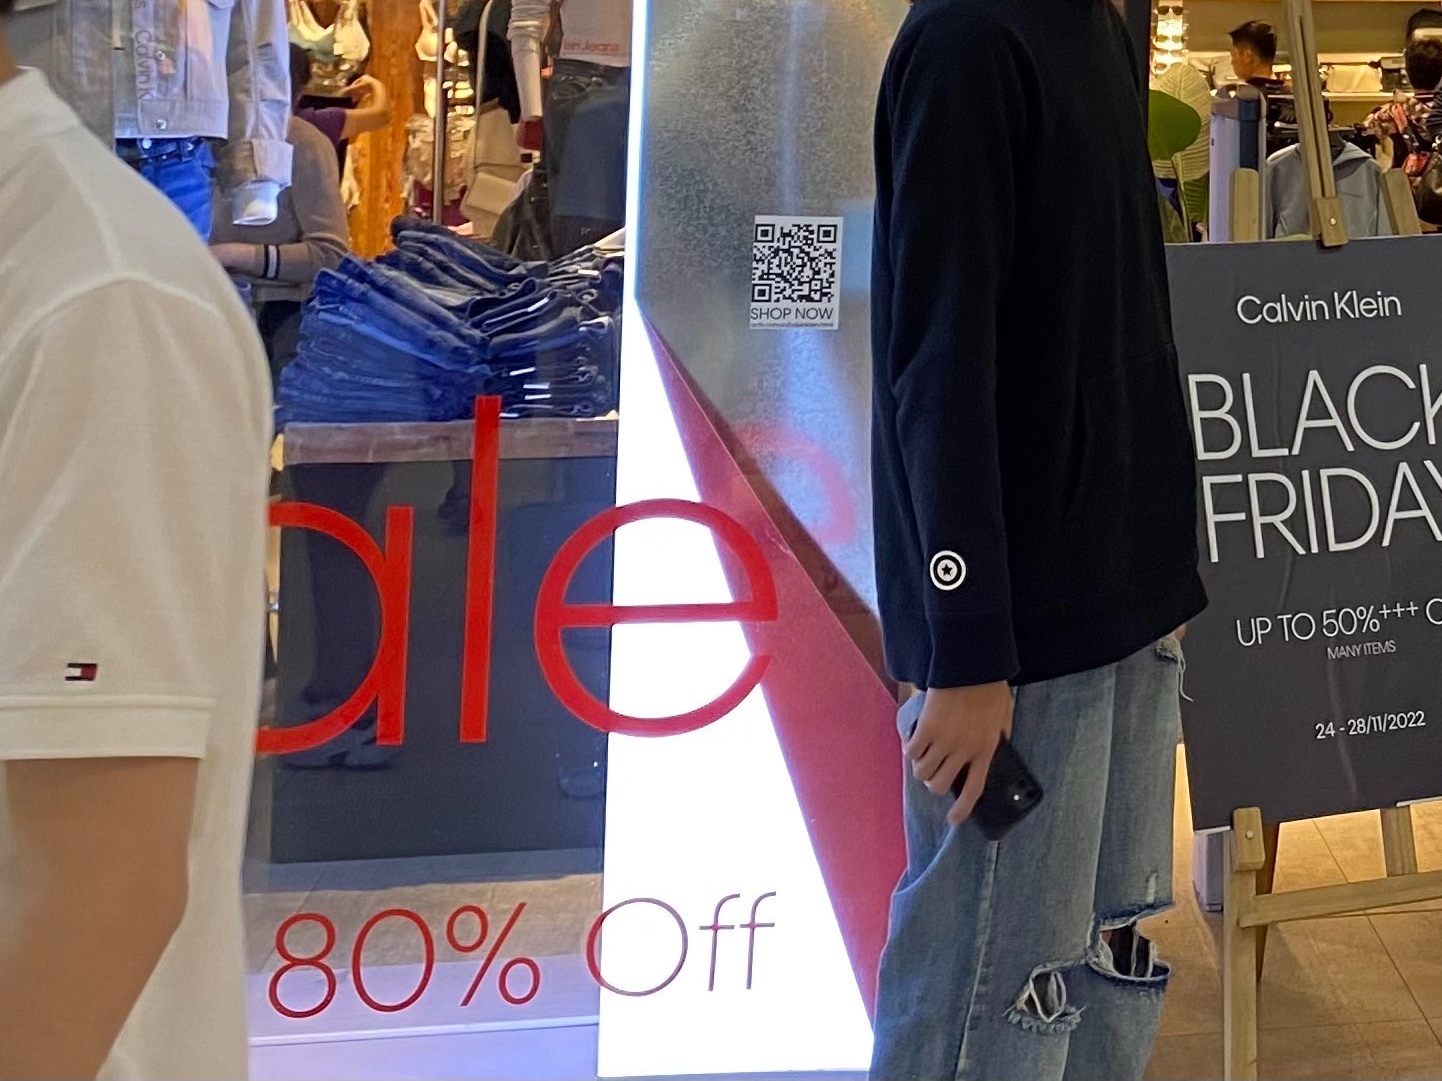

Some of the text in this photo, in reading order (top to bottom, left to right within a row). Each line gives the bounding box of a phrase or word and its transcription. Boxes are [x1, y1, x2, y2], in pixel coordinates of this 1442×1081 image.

[750, 306, 834, 320] SHOP NOW
[1236, 290, 1402, 324] Calvin Klein
[254, 394, 779, 754] ale
[1236, 617, 1273, 647] UP
[1277, 612, 1316, 641] TO
[1326, 639, 1397, 660] MANY ITEMS
[1315, 721, 1336, 740] 24
[1347, 710, 1427, 736] 28/11/2022
[268, 890, 778, 1019] 80% Off
